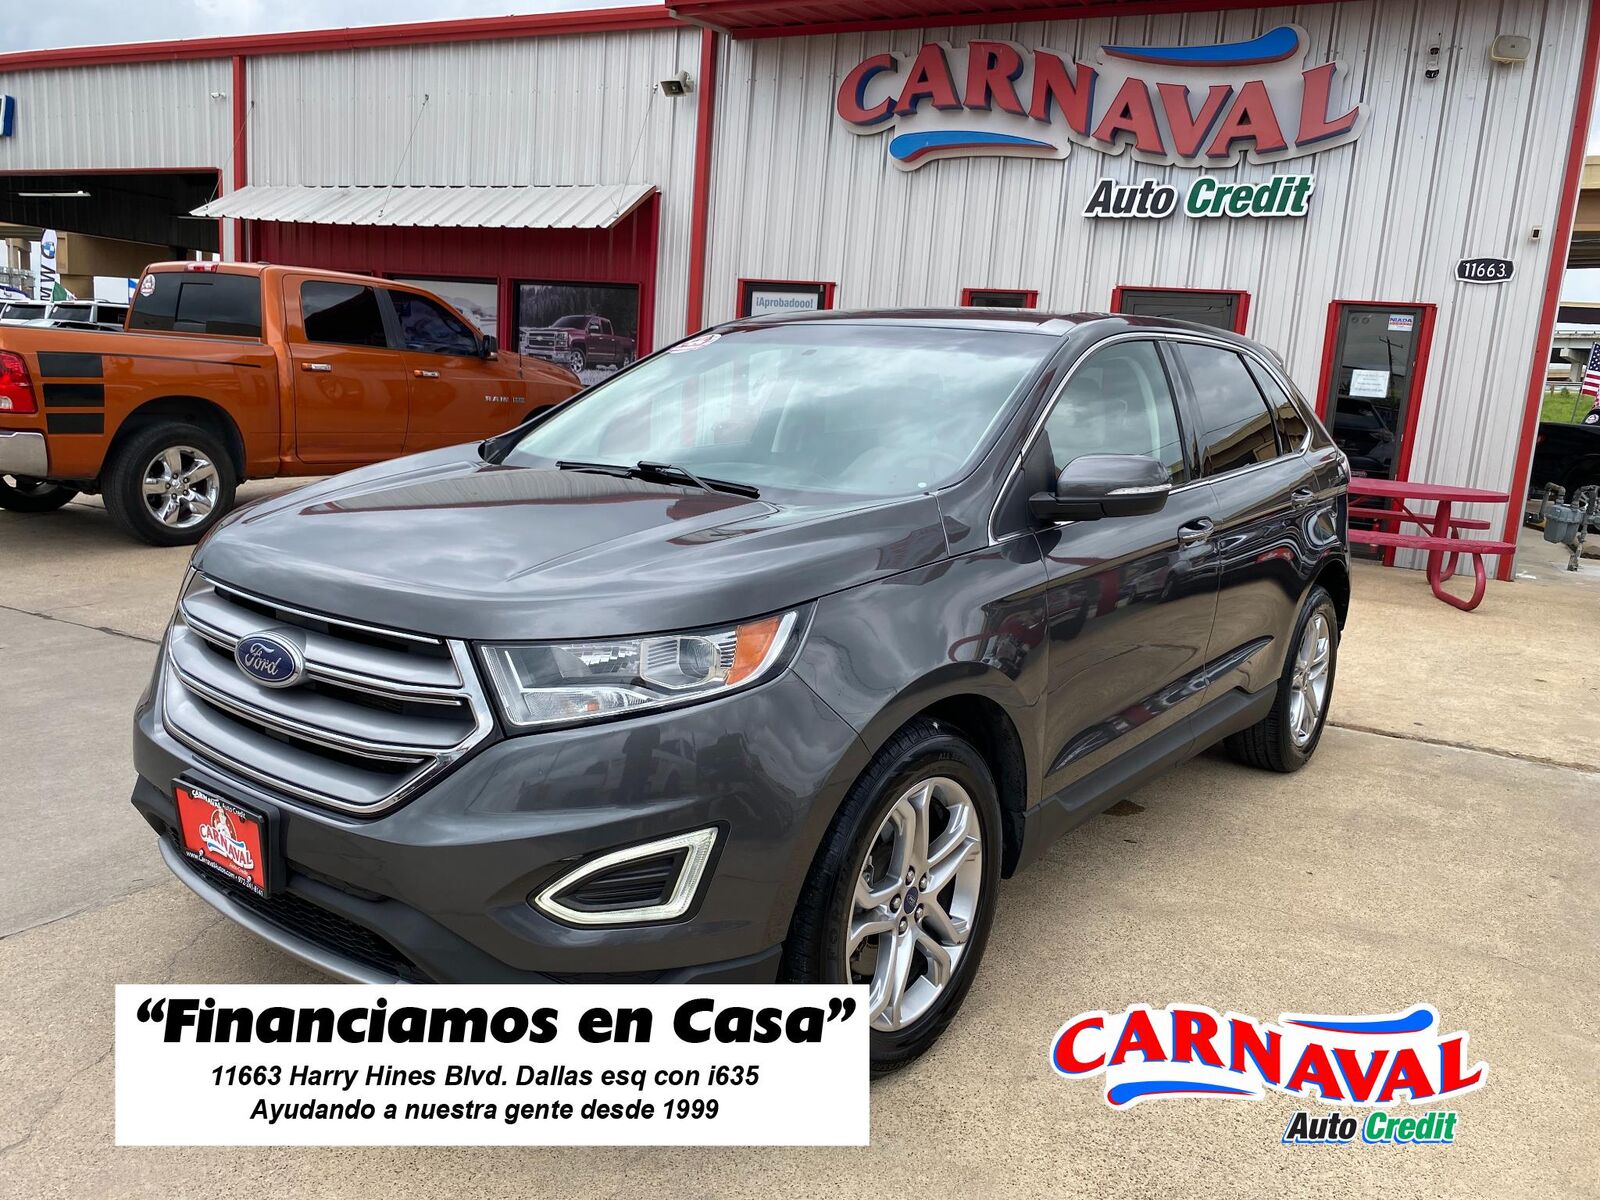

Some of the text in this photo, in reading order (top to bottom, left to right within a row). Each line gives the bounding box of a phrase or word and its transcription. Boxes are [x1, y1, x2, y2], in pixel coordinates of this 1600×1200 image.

[838, 41, 1360, 158] CARNAVAL
[1085, 174, 1312, 215] Auto Credit
[1463, 262, 1507, 278] 11663
[244, 642, 283, 676] Ford
[199, 824, 254, 866] CARNAVAL
